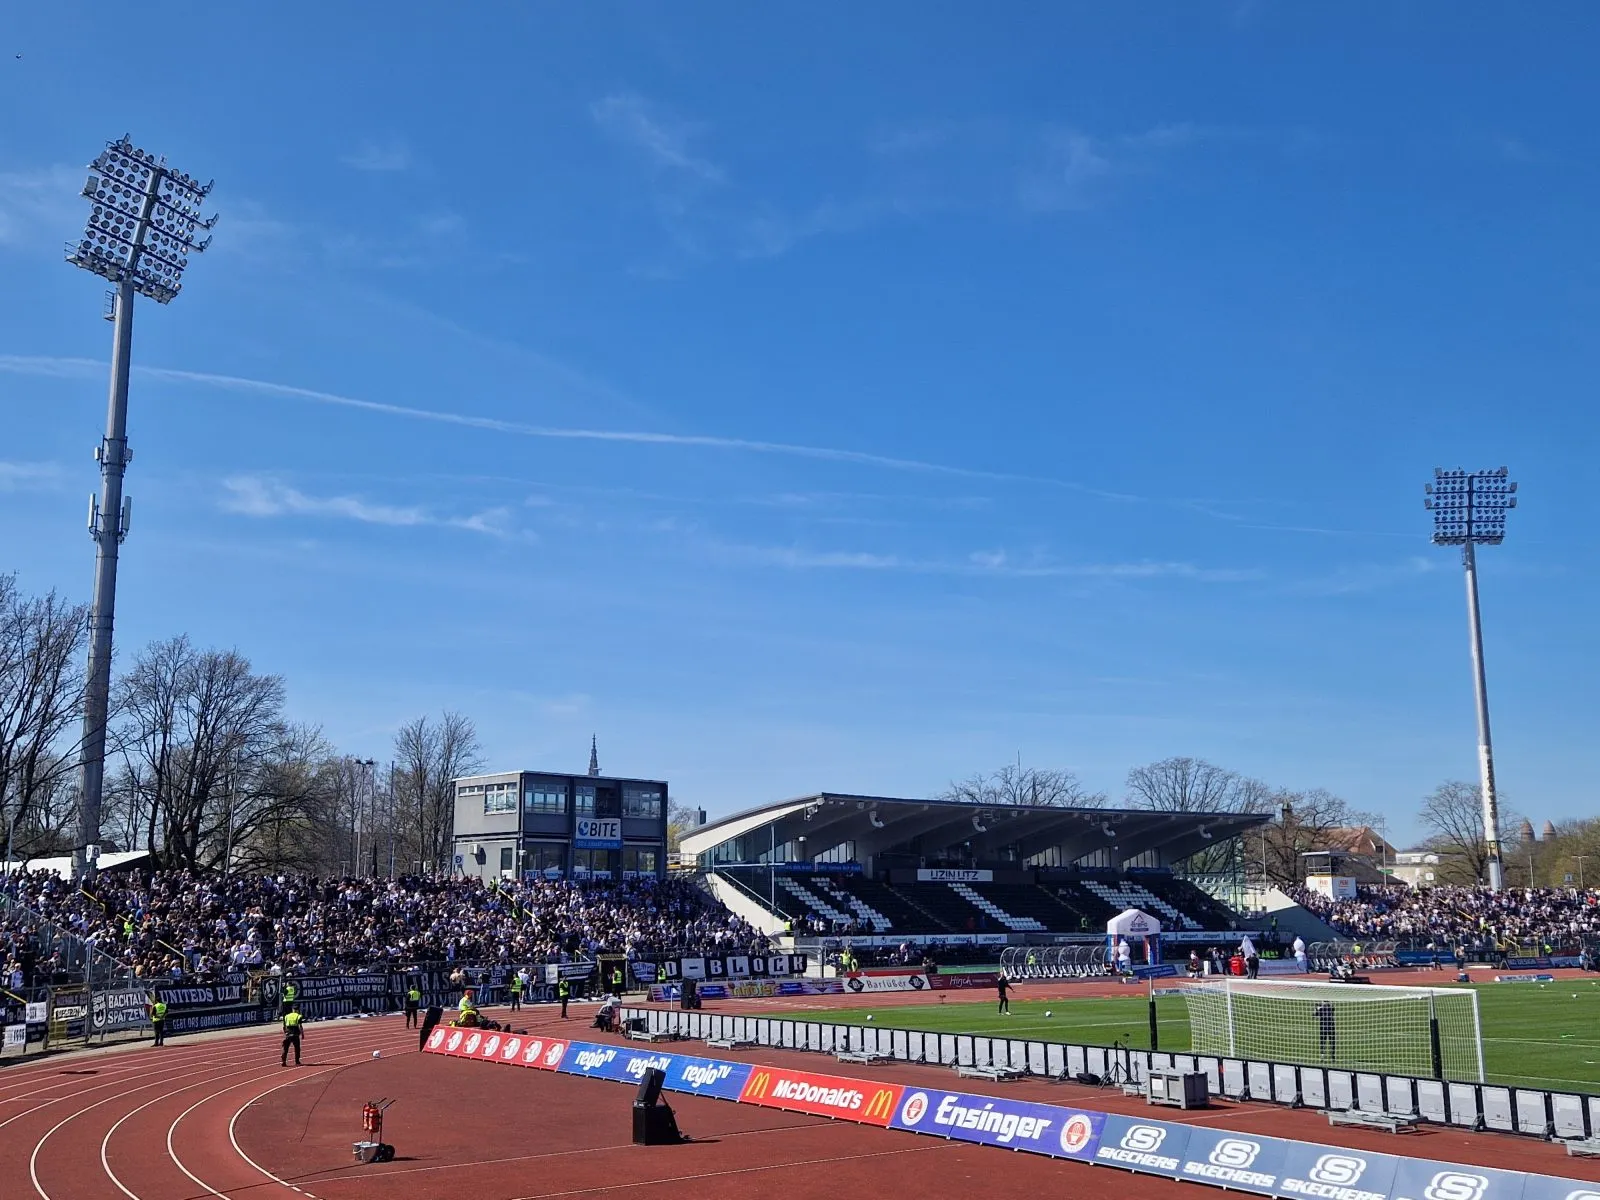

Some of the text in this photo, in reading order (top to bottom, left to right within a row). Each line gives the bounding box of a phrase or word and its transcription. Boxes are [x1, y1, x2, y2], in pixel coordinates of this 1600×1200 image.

[590, 822, 617, 837] BITE
[108, 992, 143, 1009] BACHTAL
[160, 986, 240, 1004] UNITEDS ULM
[108, 1008, 146, 1024] SPATZEN
[772, 1080, 864, 1108] McDonald's
[934, 1095, 1052, 1141] Ensinger
[1097, 1146, 1180, 1170] SKECHERS
[1183, 1162, 1276, 1188] SKECHERS
